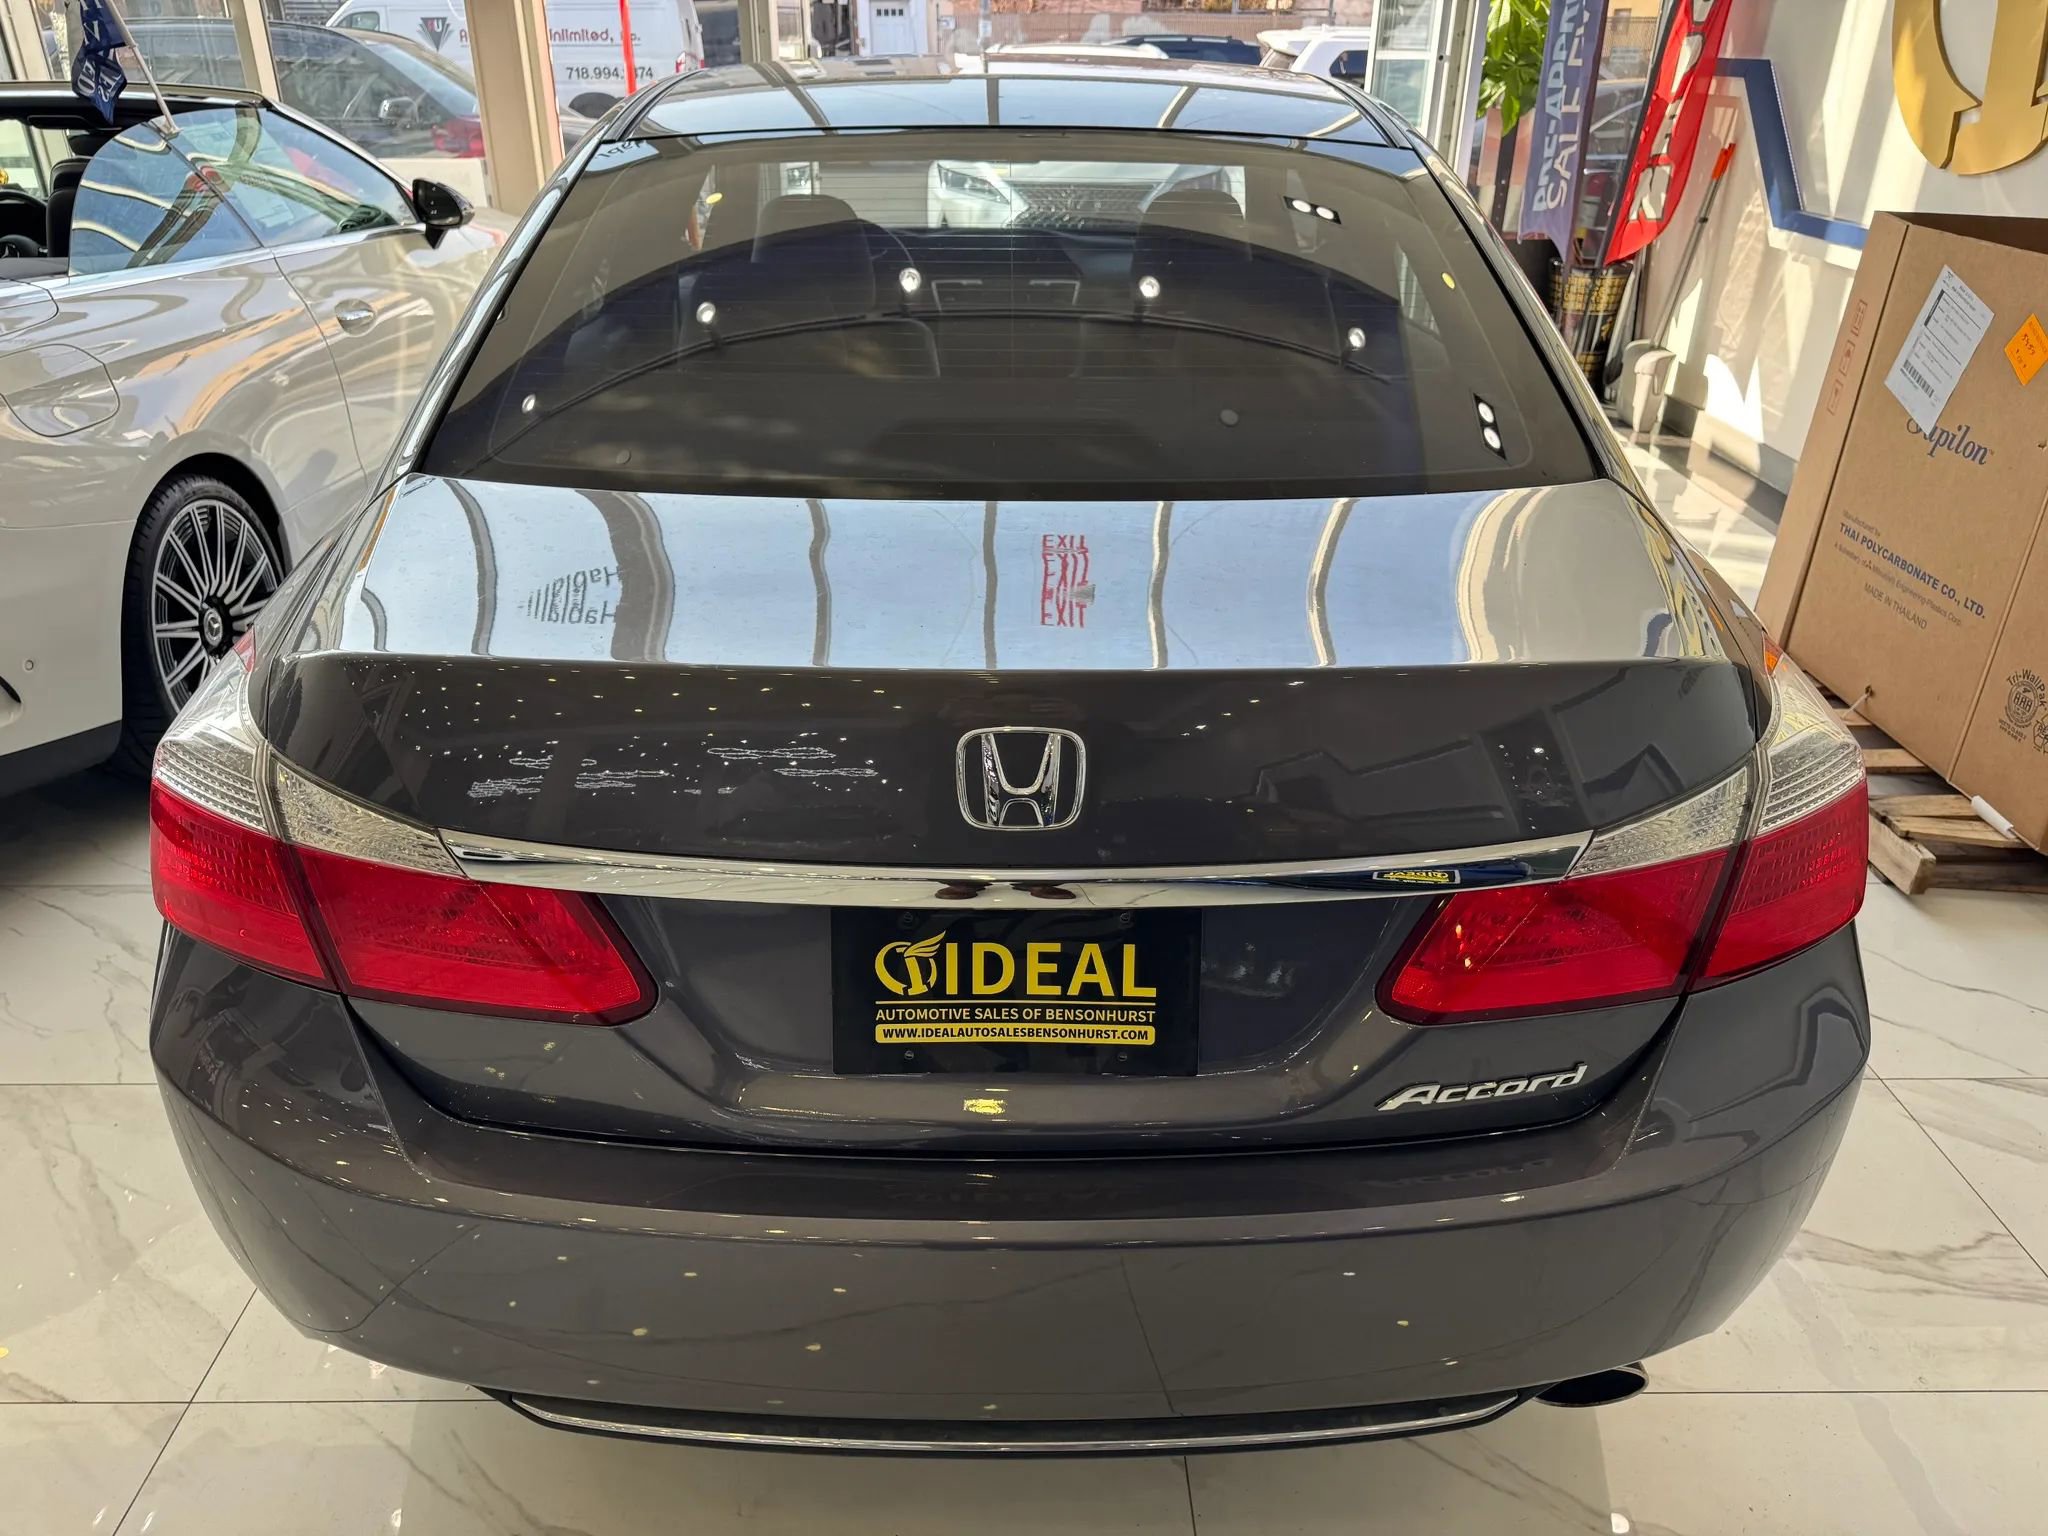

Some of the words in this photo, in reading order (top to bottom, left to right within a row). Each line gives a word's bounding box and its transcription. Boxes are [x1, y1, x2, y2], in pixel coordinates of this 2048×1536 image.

[566, 66, 653, 79] 718.994.74
[1839, 522, 1860, 542] THAI
[1860, 535, 1940, 590] POLYCARBONATE
[1941, 584, 1961, 606] CO.,
[1963, 597, 1986, 619] LTD.
[1864, 583, 1883, 602] MADE
[1885, 594, 1892, 607] IN
[1893, 600, 1928, 630] THAILAND
[946, 942, 1157, 998] IDEAL
[875, 1008, 971, 1021] AUTOMOTIVE
[974, 1008, 1019, 1021] SALES
[1022, 1008, 1042, 1021] OF
[1045, 1008, 1156, 1023] BENSONHURST
[882, 1027, 1149, 1041] WWW.IDEALAUTOSALESBENSONHURST.COM
[1377, 1063, 1588, 1112] Accord
